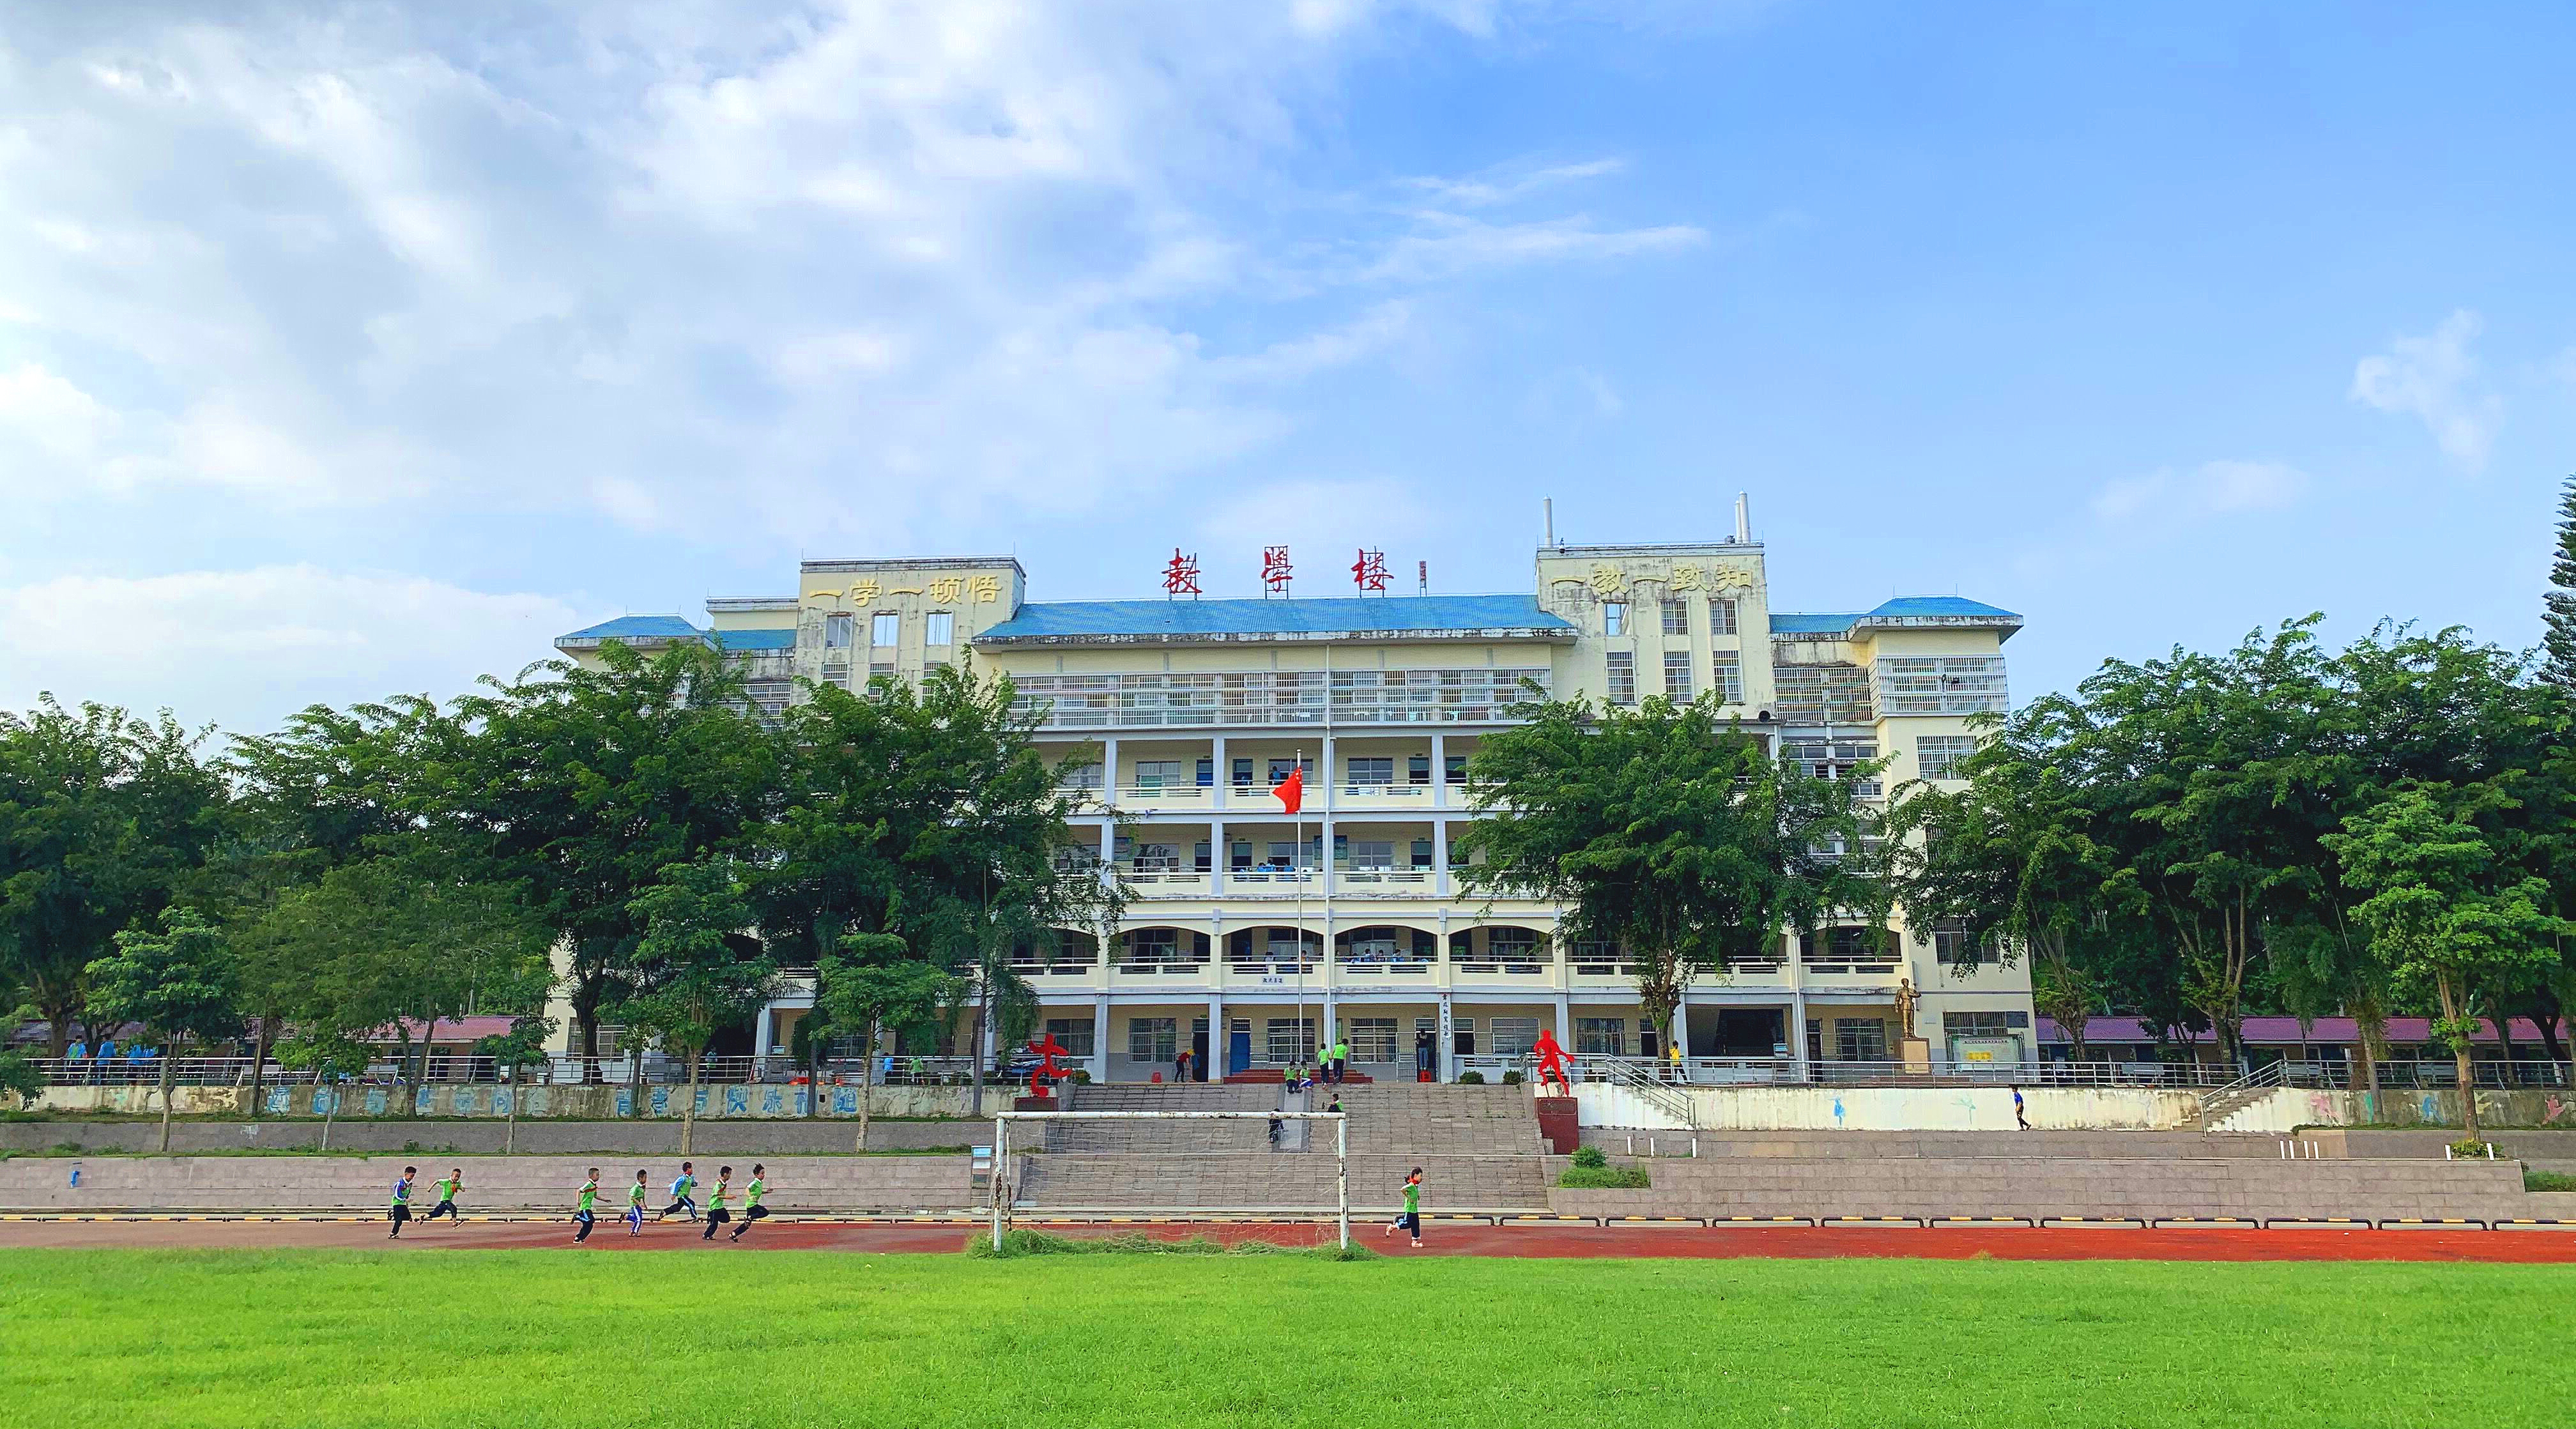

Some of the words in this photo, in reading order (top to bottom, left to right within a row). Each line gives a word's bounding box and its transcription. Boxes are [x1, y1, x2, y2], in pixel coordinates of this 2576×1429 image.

[809, 574, 1003, 607] 一学一顿悟
[1551, 563, 1753, 594] 一教一致知
